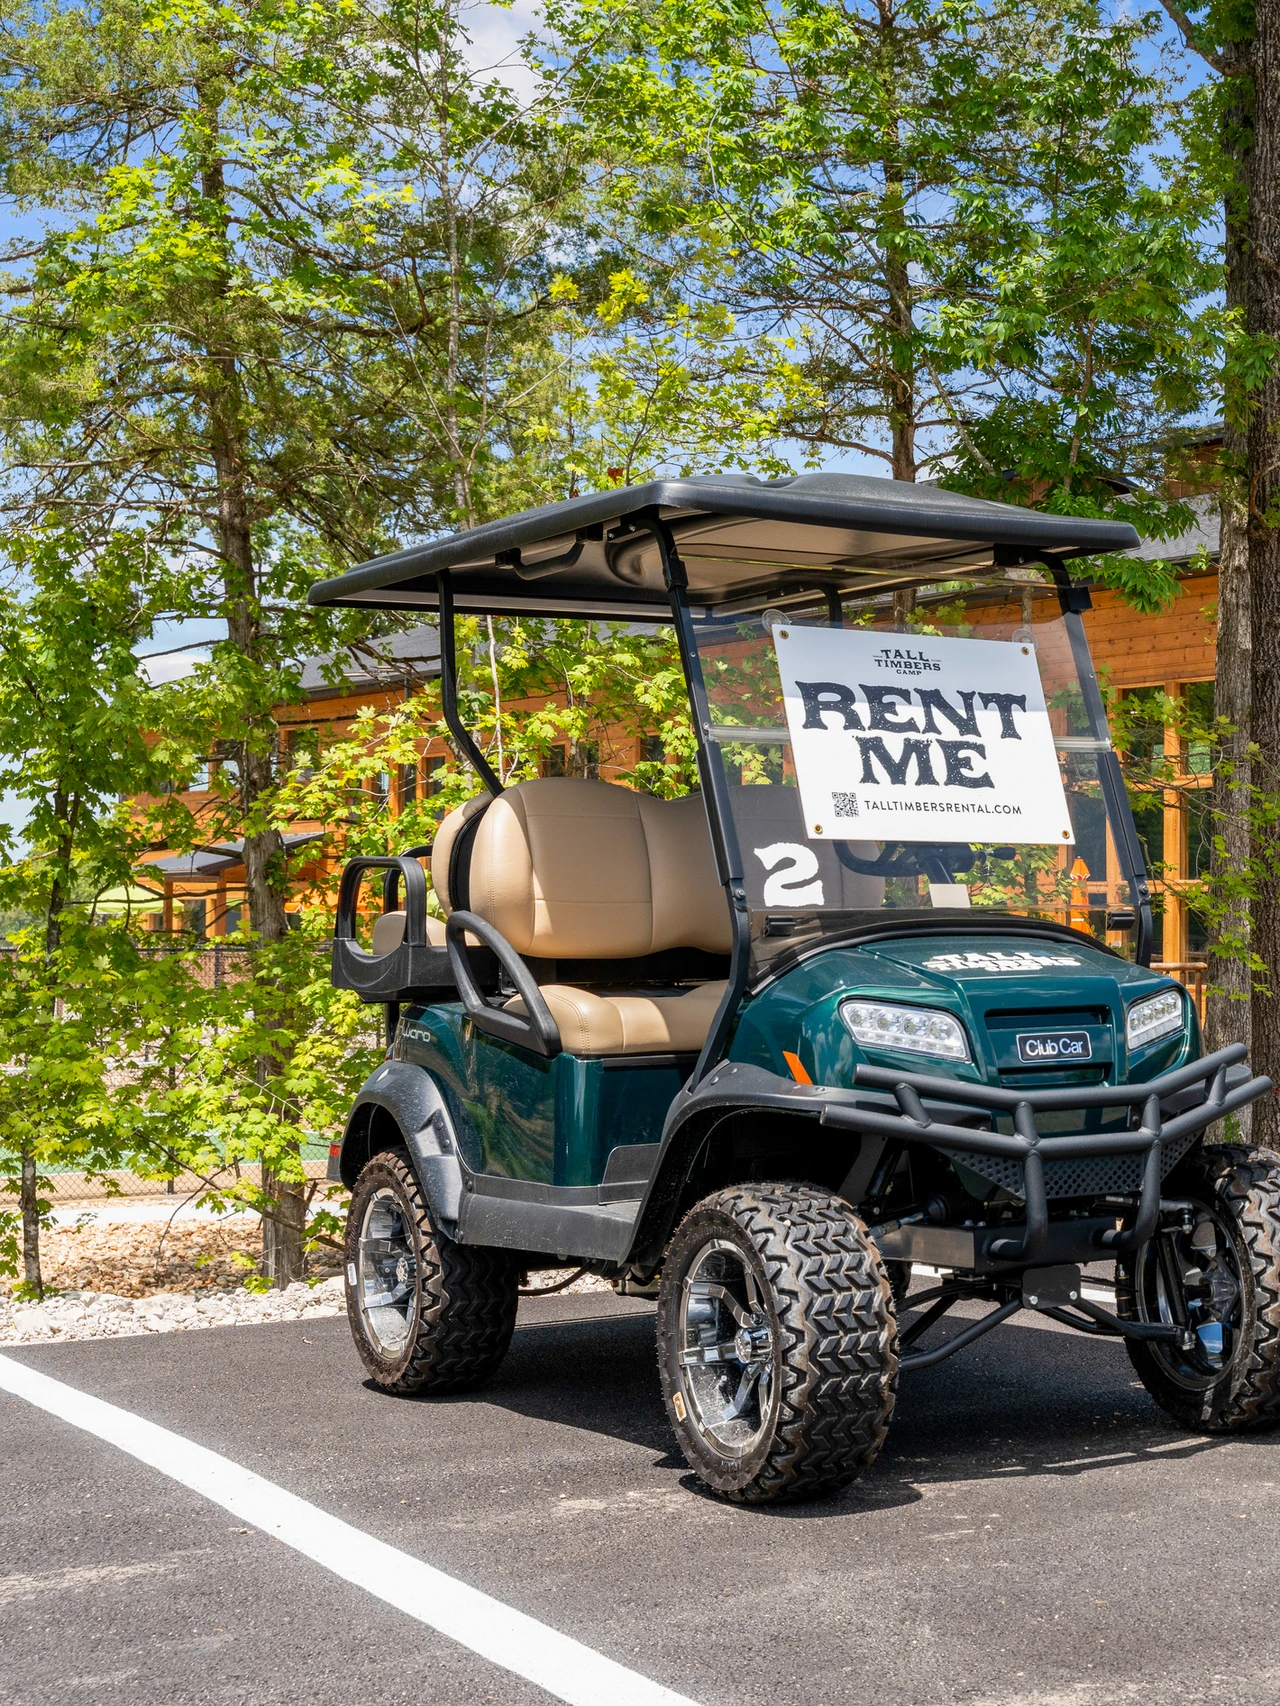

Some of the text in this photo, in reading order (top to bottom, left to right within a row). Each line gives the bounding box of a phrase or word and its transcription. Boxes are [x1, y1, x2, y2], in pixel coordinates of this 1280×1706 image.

[874, 659, 941, 671] TIMBERS
[880, 649, 930, 662] TALL
[795, 681, 1027, 740] RENT
[853, 736, 995, 789] ME
[864, 800, 1022, 815] TALLTIMBERSRENTAL.COM
[753, 842, 825, 907] 2
[1025, 1037, 1084, 1056] Club Car
